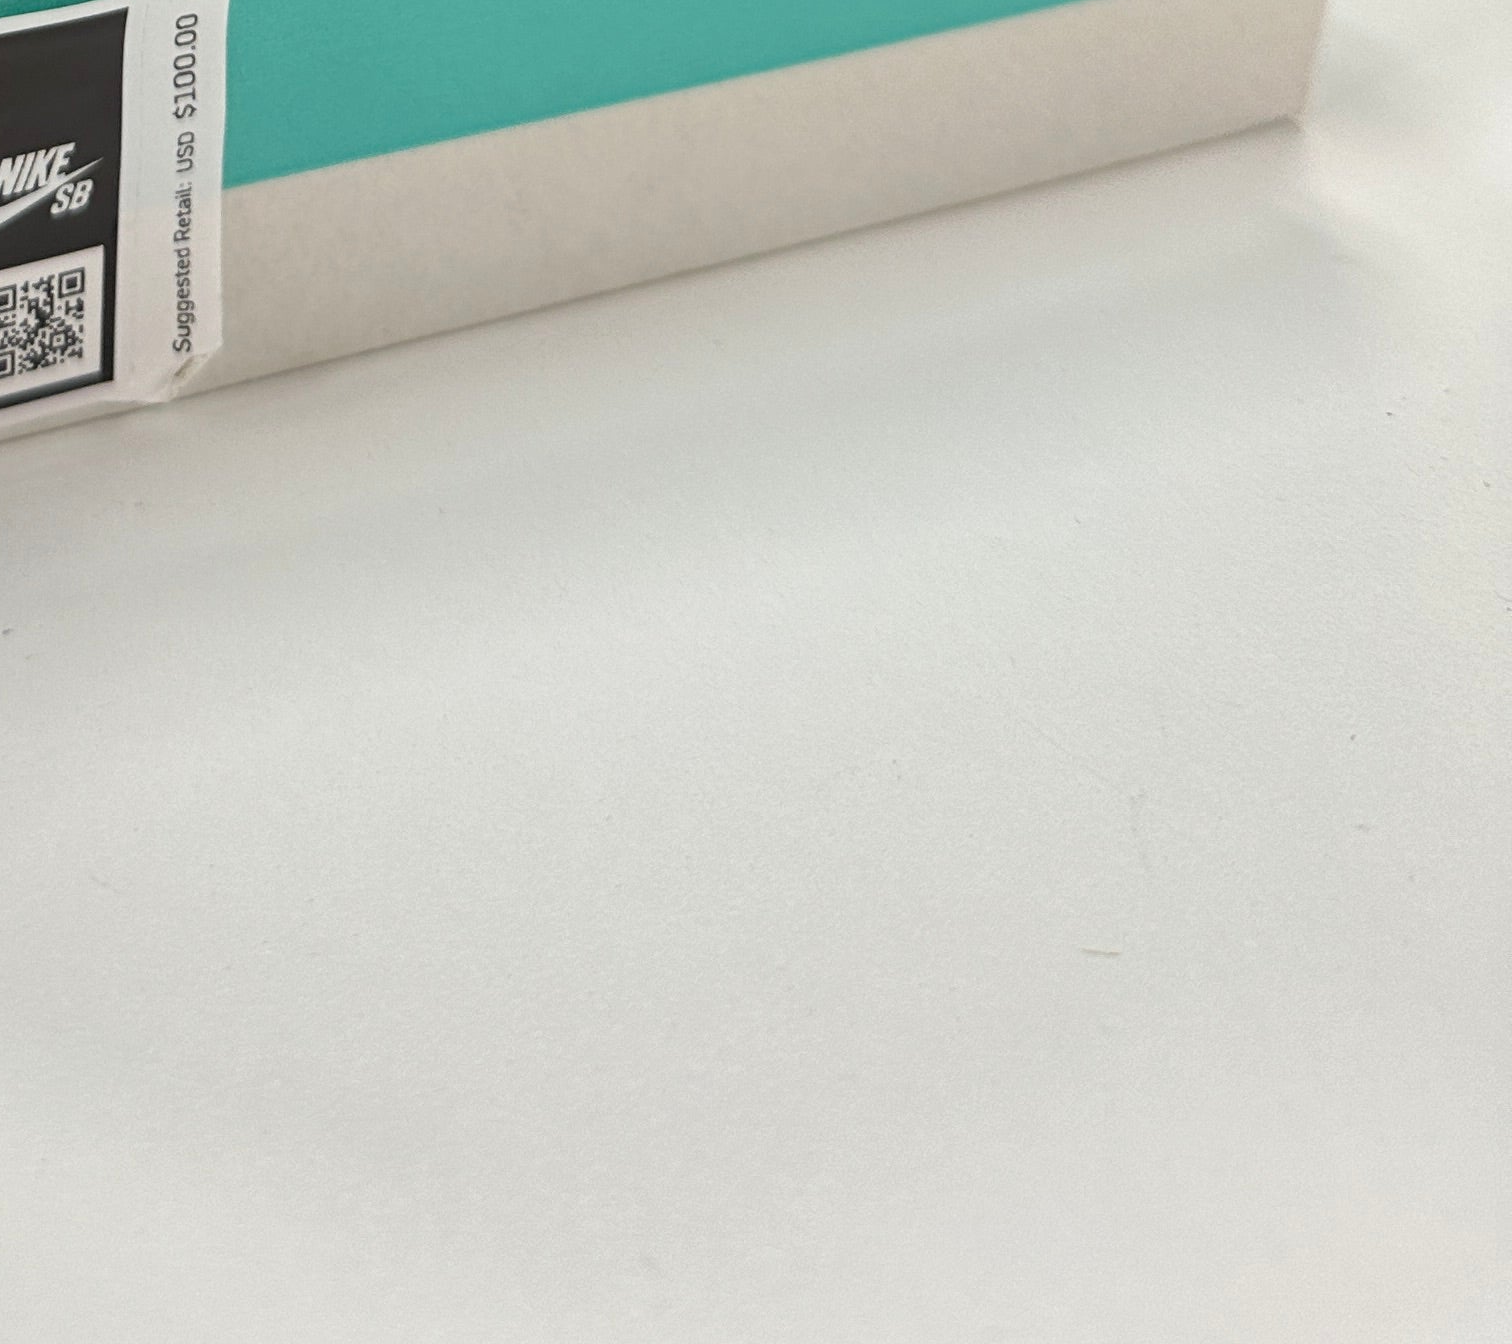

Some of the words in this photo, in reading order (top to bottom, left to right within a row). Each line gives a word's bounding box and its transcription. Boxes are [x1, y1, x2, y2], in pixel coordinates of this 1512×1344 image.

[172, 13, 199, 120] $100.00
[176, 131, 196, 174] USD
[50, 178, 94, 214] SB
[174, 181, 193, 244] Retail:
[172, 247, 196, 354] Suggested
